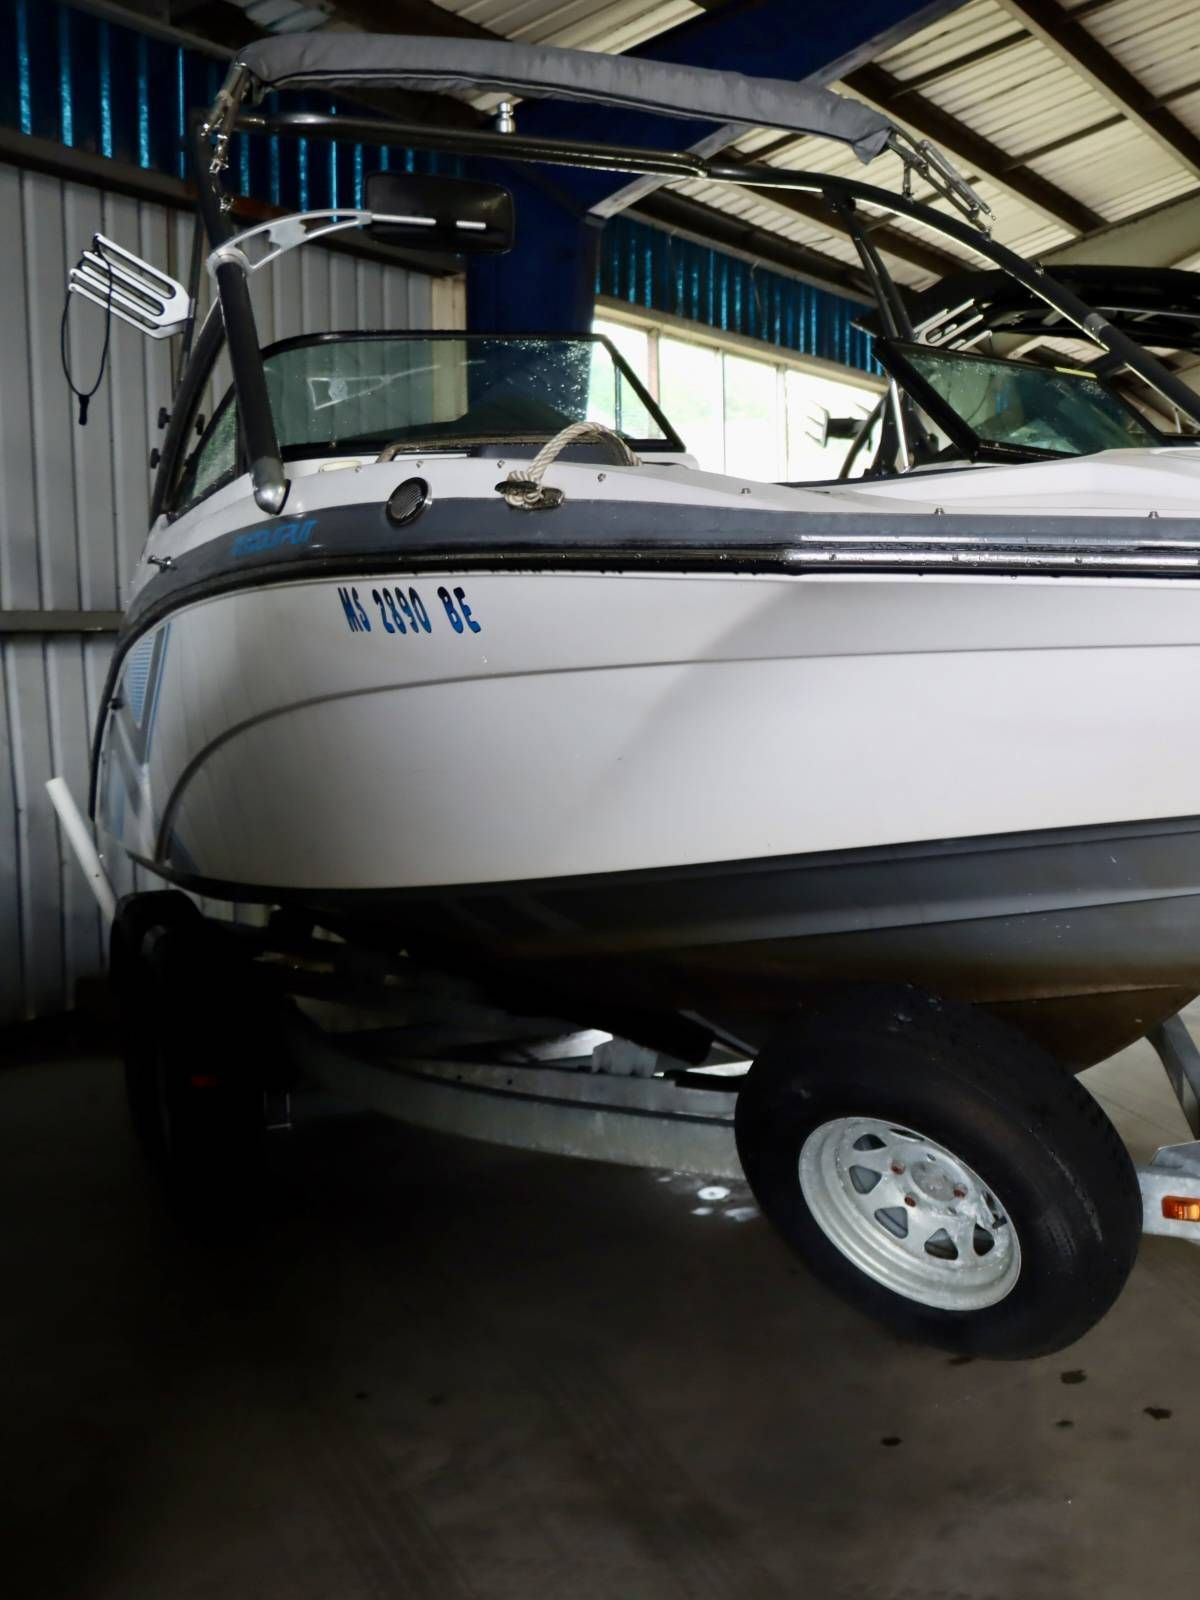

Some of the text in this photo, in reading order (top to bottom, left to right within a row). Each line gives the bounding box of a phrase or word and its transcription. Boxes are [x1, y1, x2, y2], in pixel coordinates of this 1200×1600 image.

[337, 586, 481, 634] MS 2890 BE
